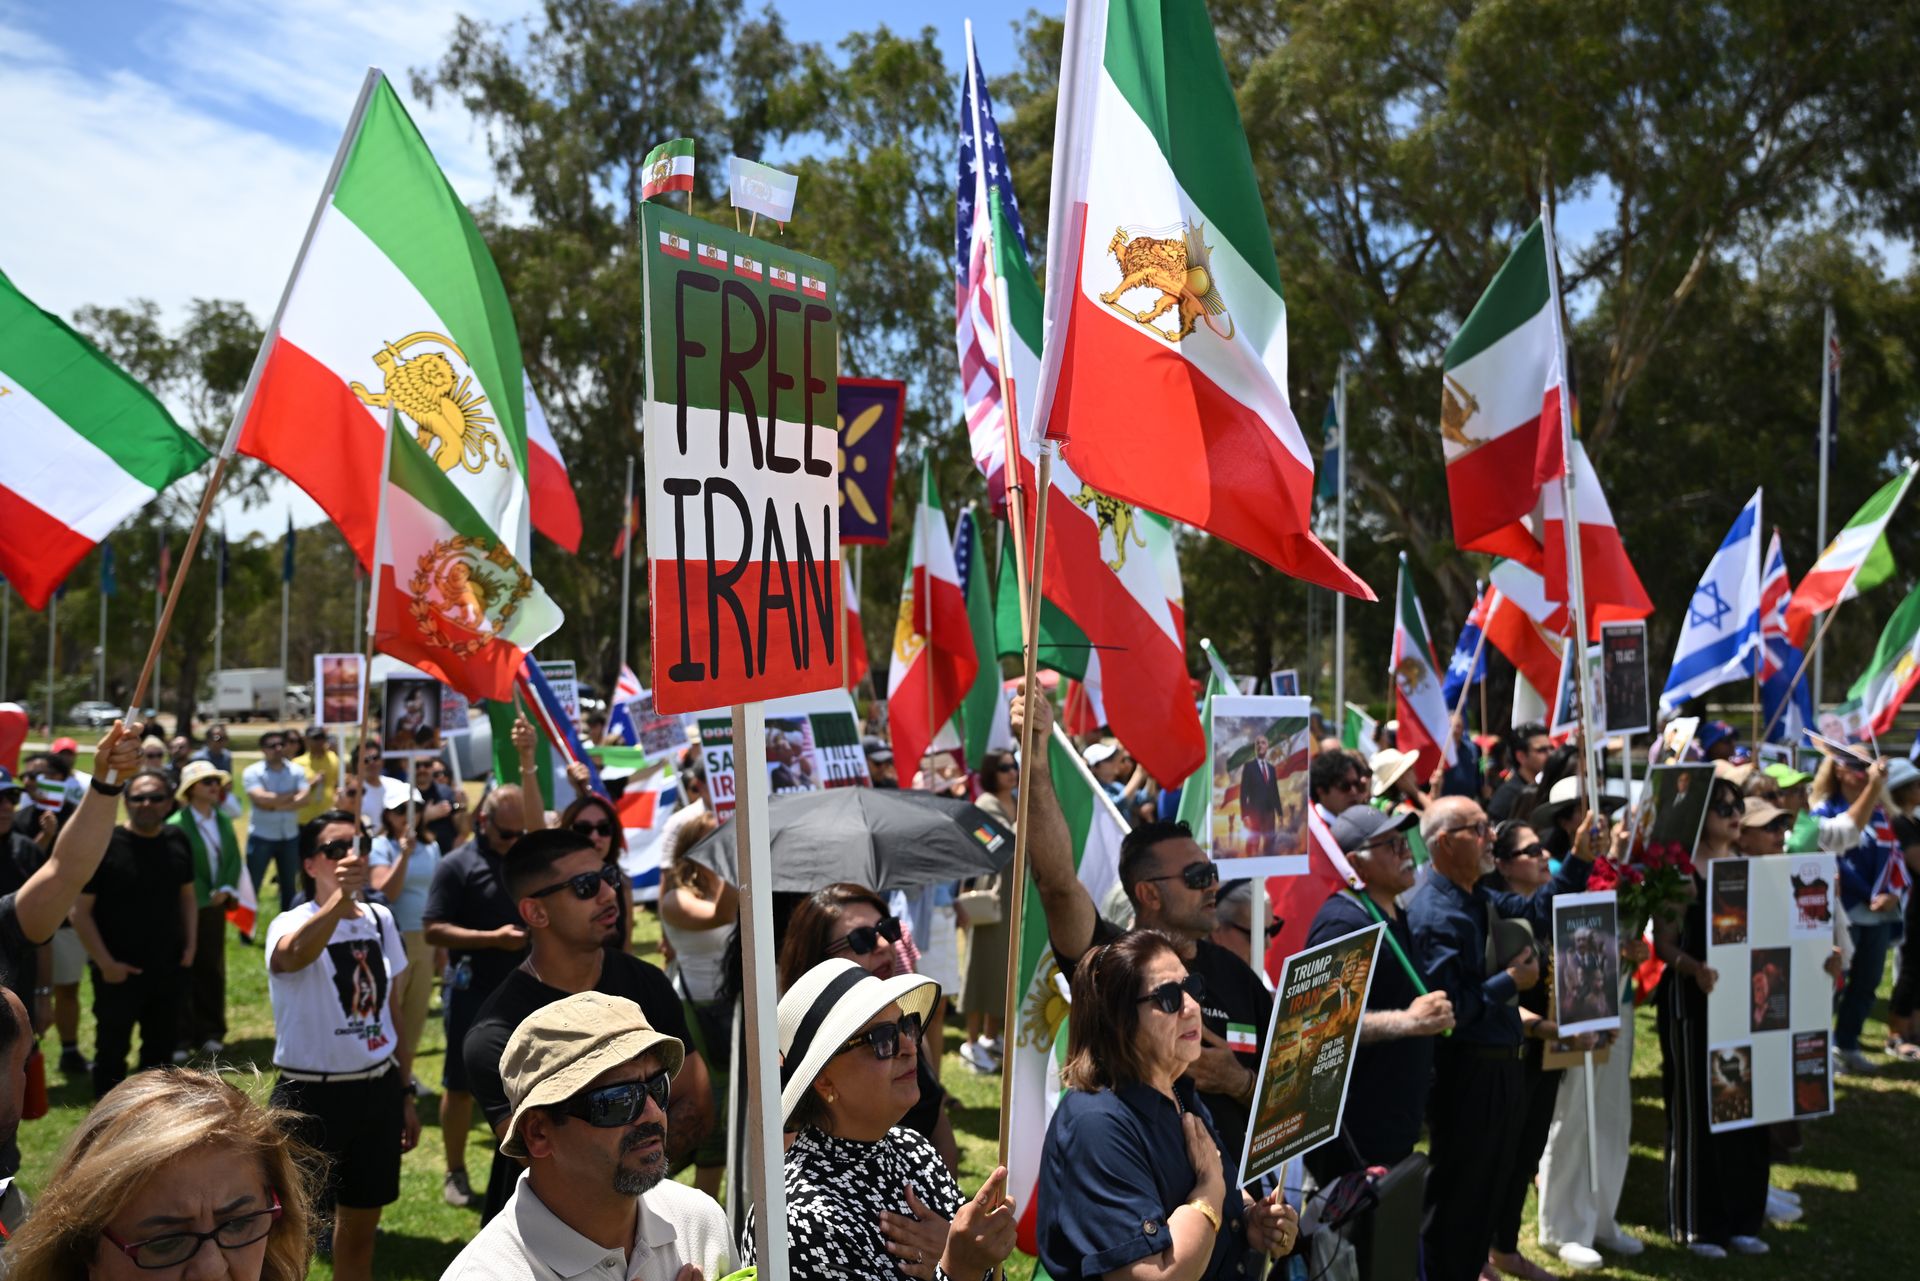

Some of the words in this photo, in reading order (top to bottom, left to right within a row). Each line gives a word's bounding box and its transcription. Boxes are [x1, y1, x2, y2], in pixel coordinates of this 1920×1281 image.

[676, 270, 832, 477] FREE
[663, 477, 834, 682] IRAN
[706, 750, 734, 773] SA
[711, 774, 734, 798] IR
[1293, 954, 1333, 983] TRUMP
[1285, 980, 1311, 999] STAND
[1311, 971, 1331, 988] WITH
[1288, 986, 1321, 1015] IRAN
[1316, 1044, 1345, 1064] ISLAMIC
[1321, 1040, 1333, 1053] END
[1333, 1035, 1345, 1048] THE
[1311, 1054, 1345, 1076] REPUBLIC
[1251, 1135, 1276, 1155] KILLED
[1276, 1130, 1286, 1140] ACT
[1254, 1122, 1284, 1143] REMEMBER
[1251, 1152, 1274, 1170] SUPPORT
[1274, 1147, 1284, 1158] THE
[1283, 1138, 1303, 1153] IRANIAN
[1303, 1124, 1331, 1143] REVOLUTION
